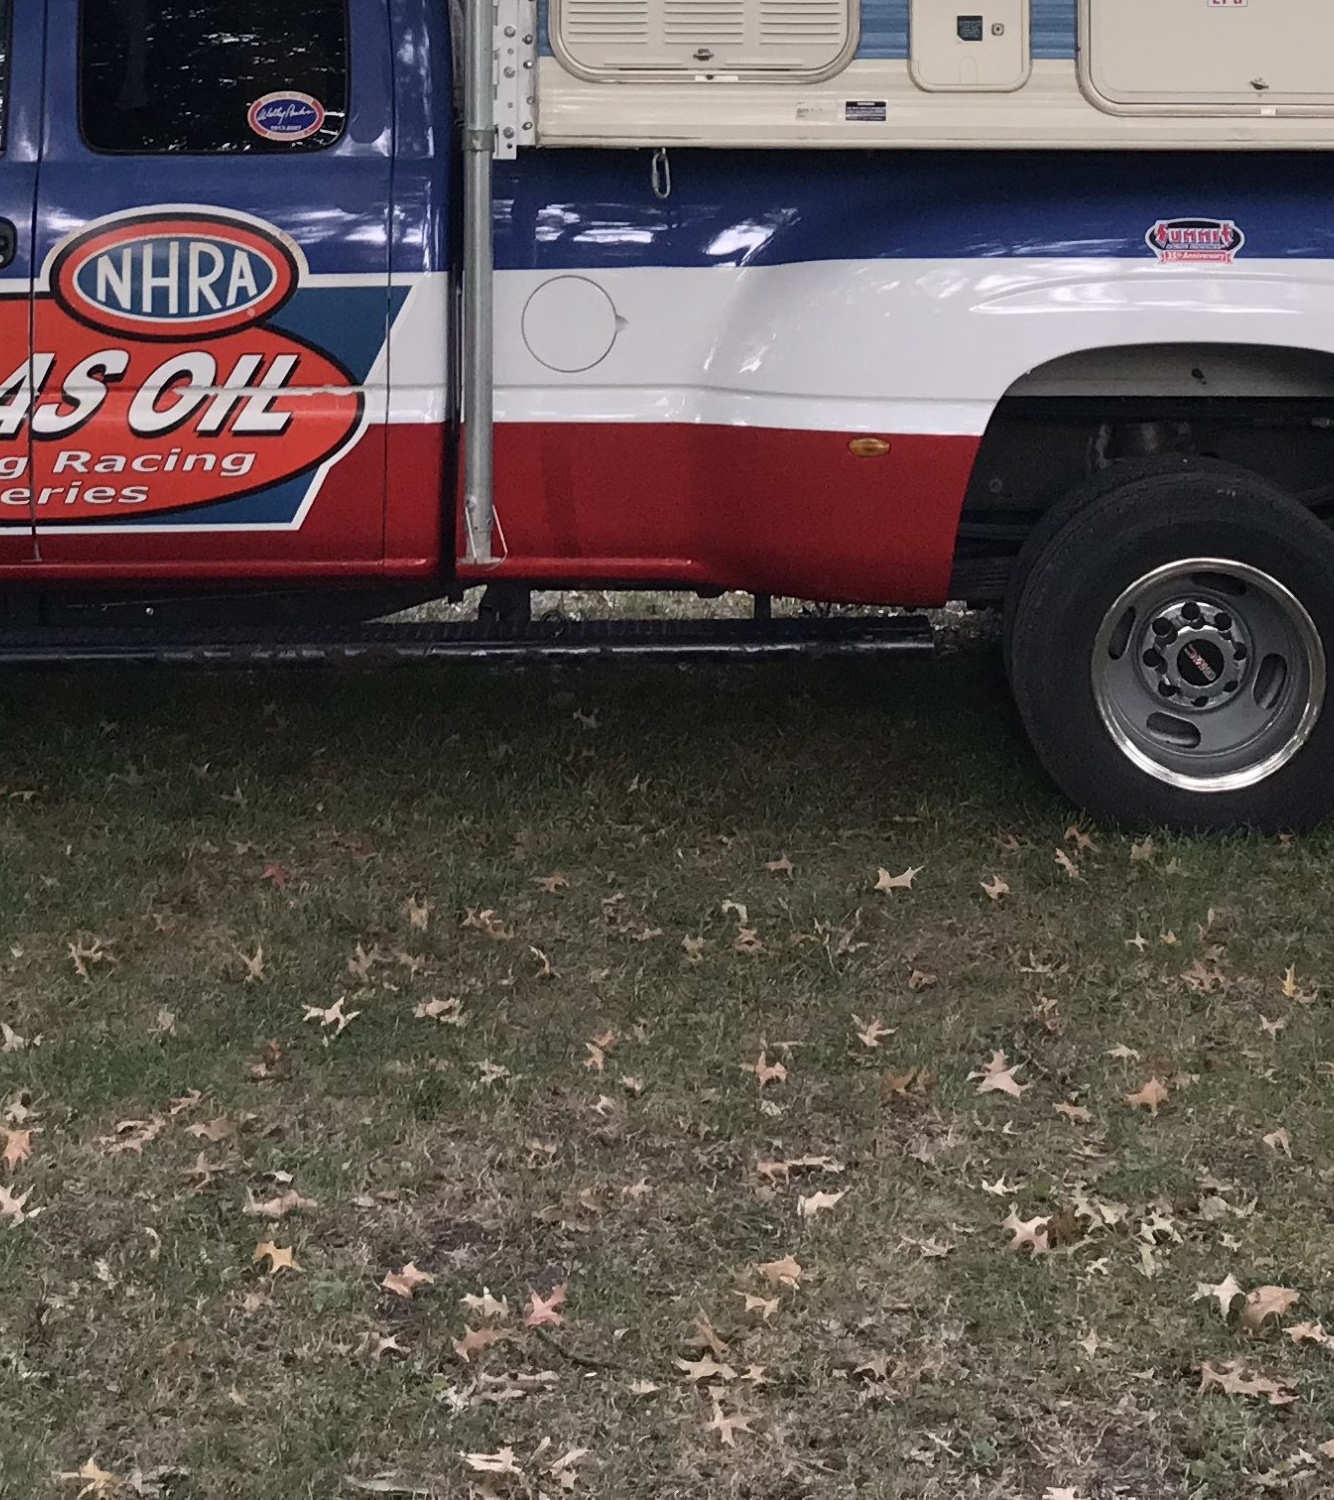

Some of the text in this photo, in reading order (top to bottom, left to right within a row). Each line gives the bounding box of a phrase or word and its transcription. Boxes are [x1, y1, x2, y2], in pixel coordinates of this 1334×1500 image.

[97, 241, 258, 314] NHRA
[127, 350, 302, 438] OIL
[52, 448, 256, 477] Racing
